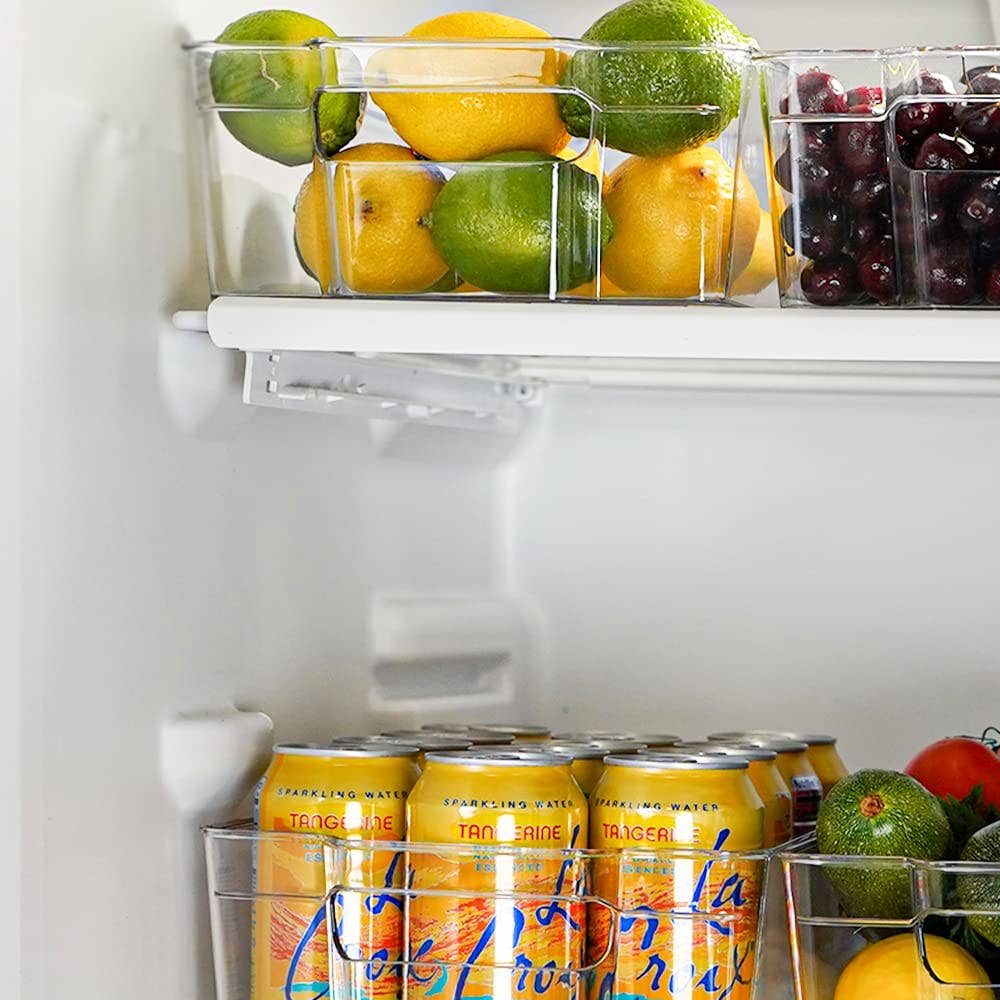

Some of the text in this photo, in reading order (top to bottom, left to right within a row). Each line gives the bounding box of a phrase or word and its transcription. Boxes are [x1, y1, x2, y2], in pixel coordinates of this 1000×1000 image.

[278, 787, 356, 799] SPARKLING
[443, 798, 573, 809] SPARKLING WATER
[670, 803, 719, 812] WATER
[289, 813, 393, 831] TANGEINE
[458, 823, 561, 841] TANERINE
[602, 823, 701, 843] TANGERIE
